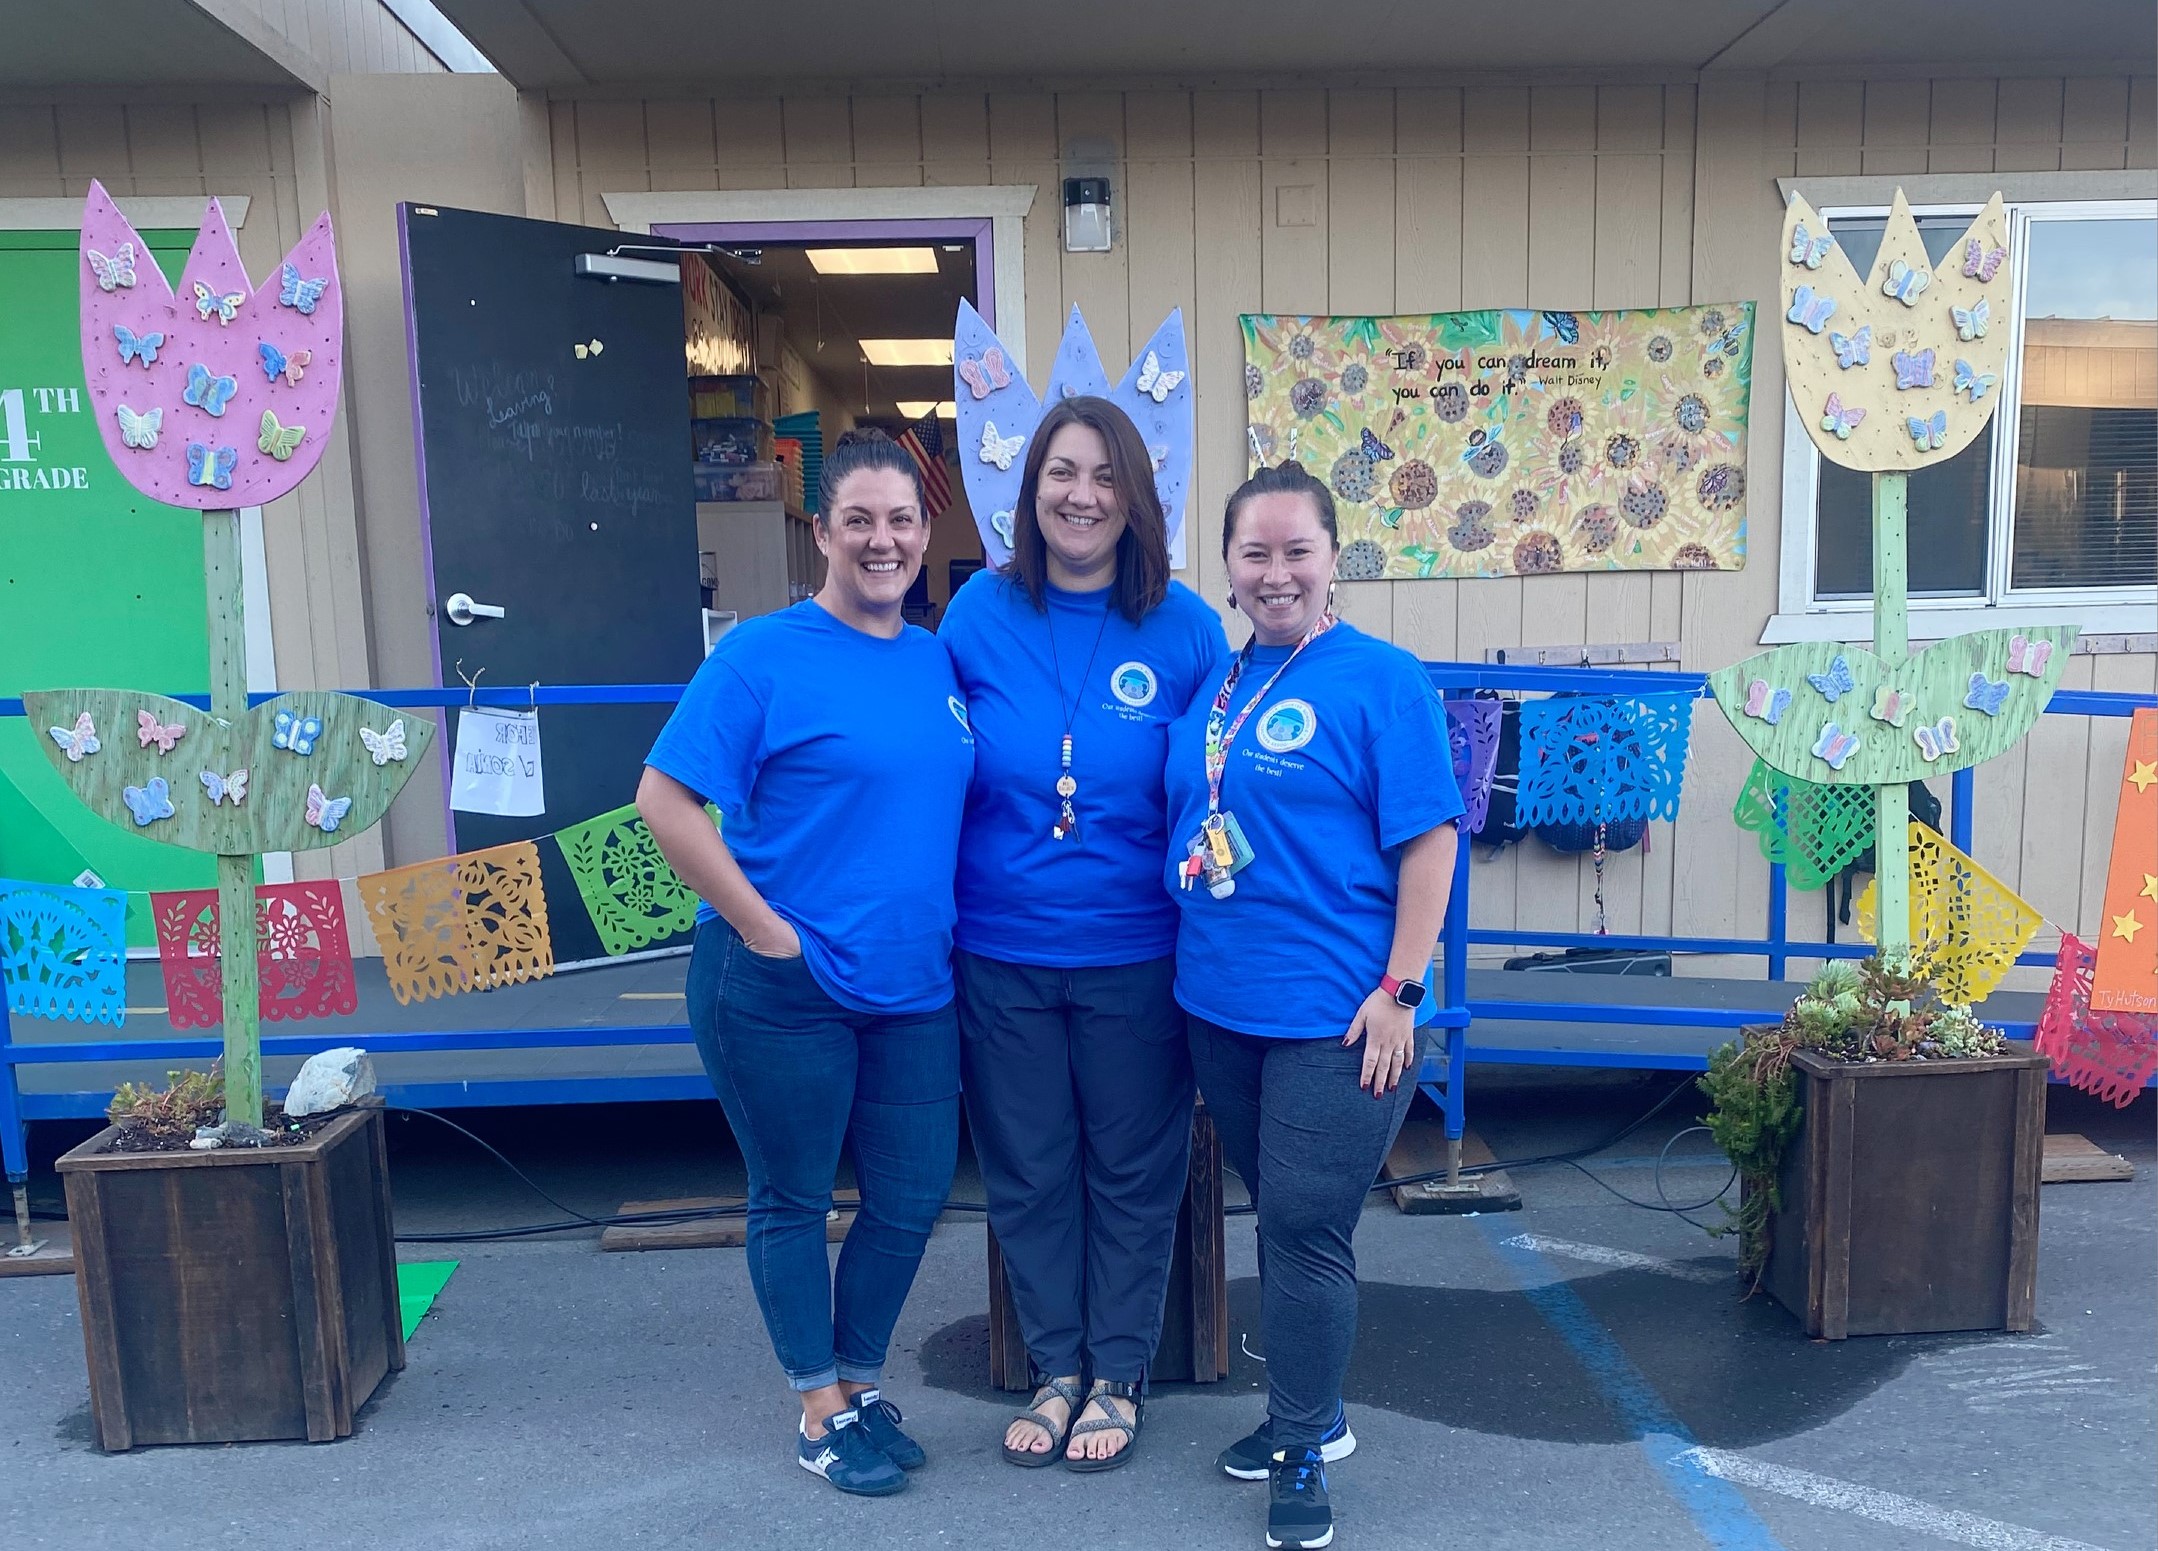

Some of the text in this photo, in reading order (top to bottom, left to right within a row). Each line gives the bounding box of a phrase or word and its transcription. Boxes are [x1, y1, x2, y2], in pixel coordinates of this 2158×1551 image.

[1435, 358, 1465, 382] you
[1477, 356, 1506, 369] can
[1526, 348, 1576, 369] dream
[1590, 350, 1607, 371] it,
[1391, 387, 1421, 405] you
[1429, 384, 1459, 398] can
[1469, 378, 1490, 396] do
[1567, 374, 1602, 390] Disney
[1242, 748, 1305, 771] Our students deserve
[1254, 764, 1265, 773] the
